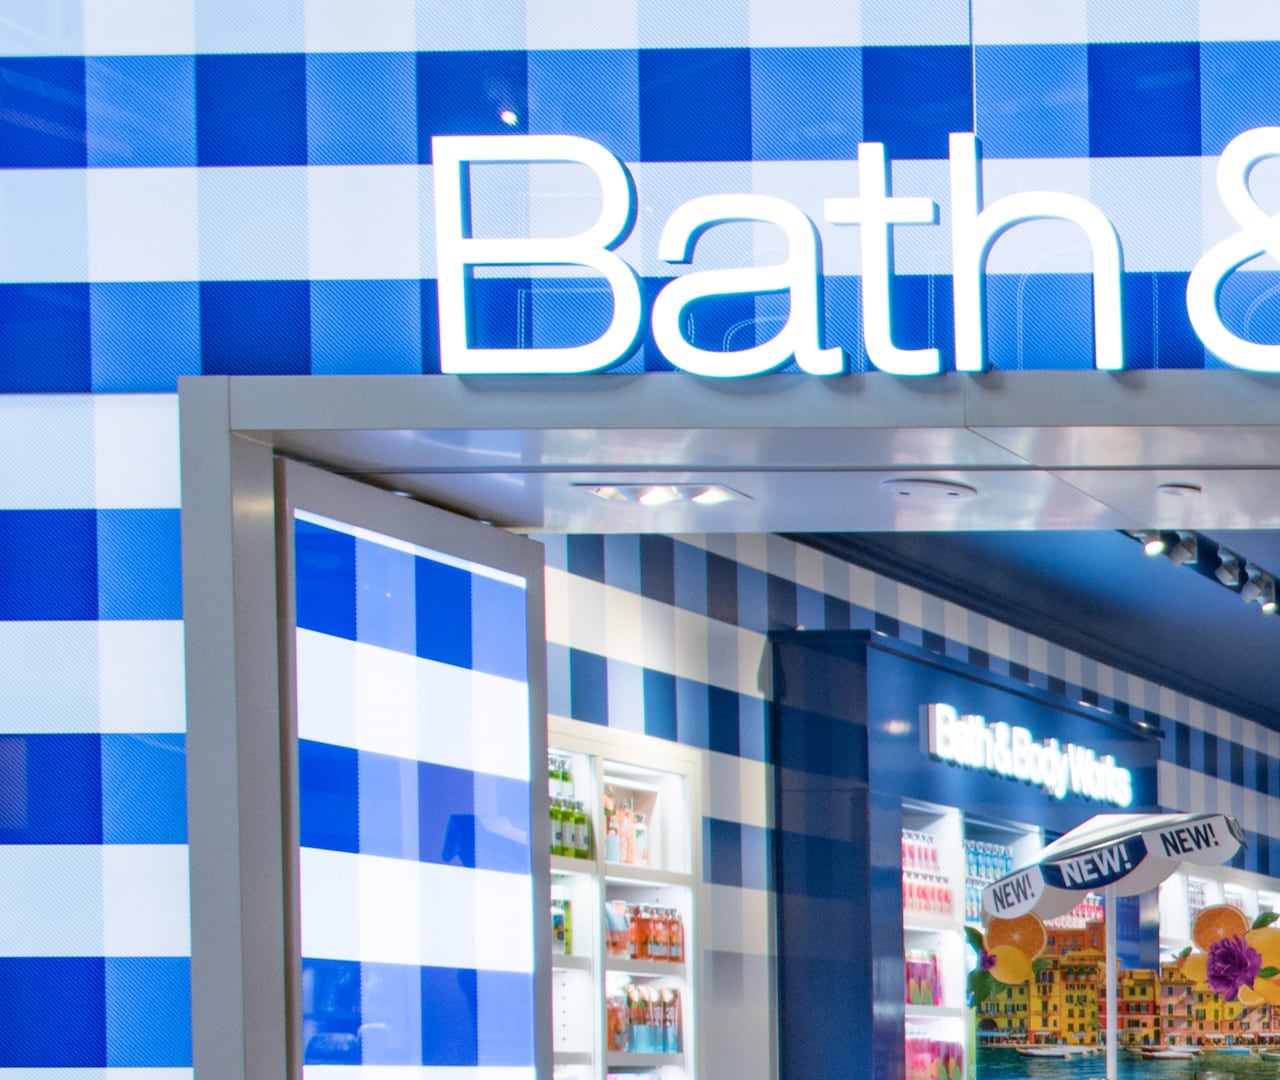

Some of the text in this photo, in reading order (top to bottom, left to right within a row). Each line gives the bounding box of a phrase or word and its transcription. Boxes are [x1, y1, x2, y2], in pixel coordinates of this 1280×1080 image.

[430, 131, 1125, 378] Bath
[1159, 821, 1220, 858] NEW!
[1059, 842, 1133, 888] NEW!
[992, 873, 1036, 913] NEW!
